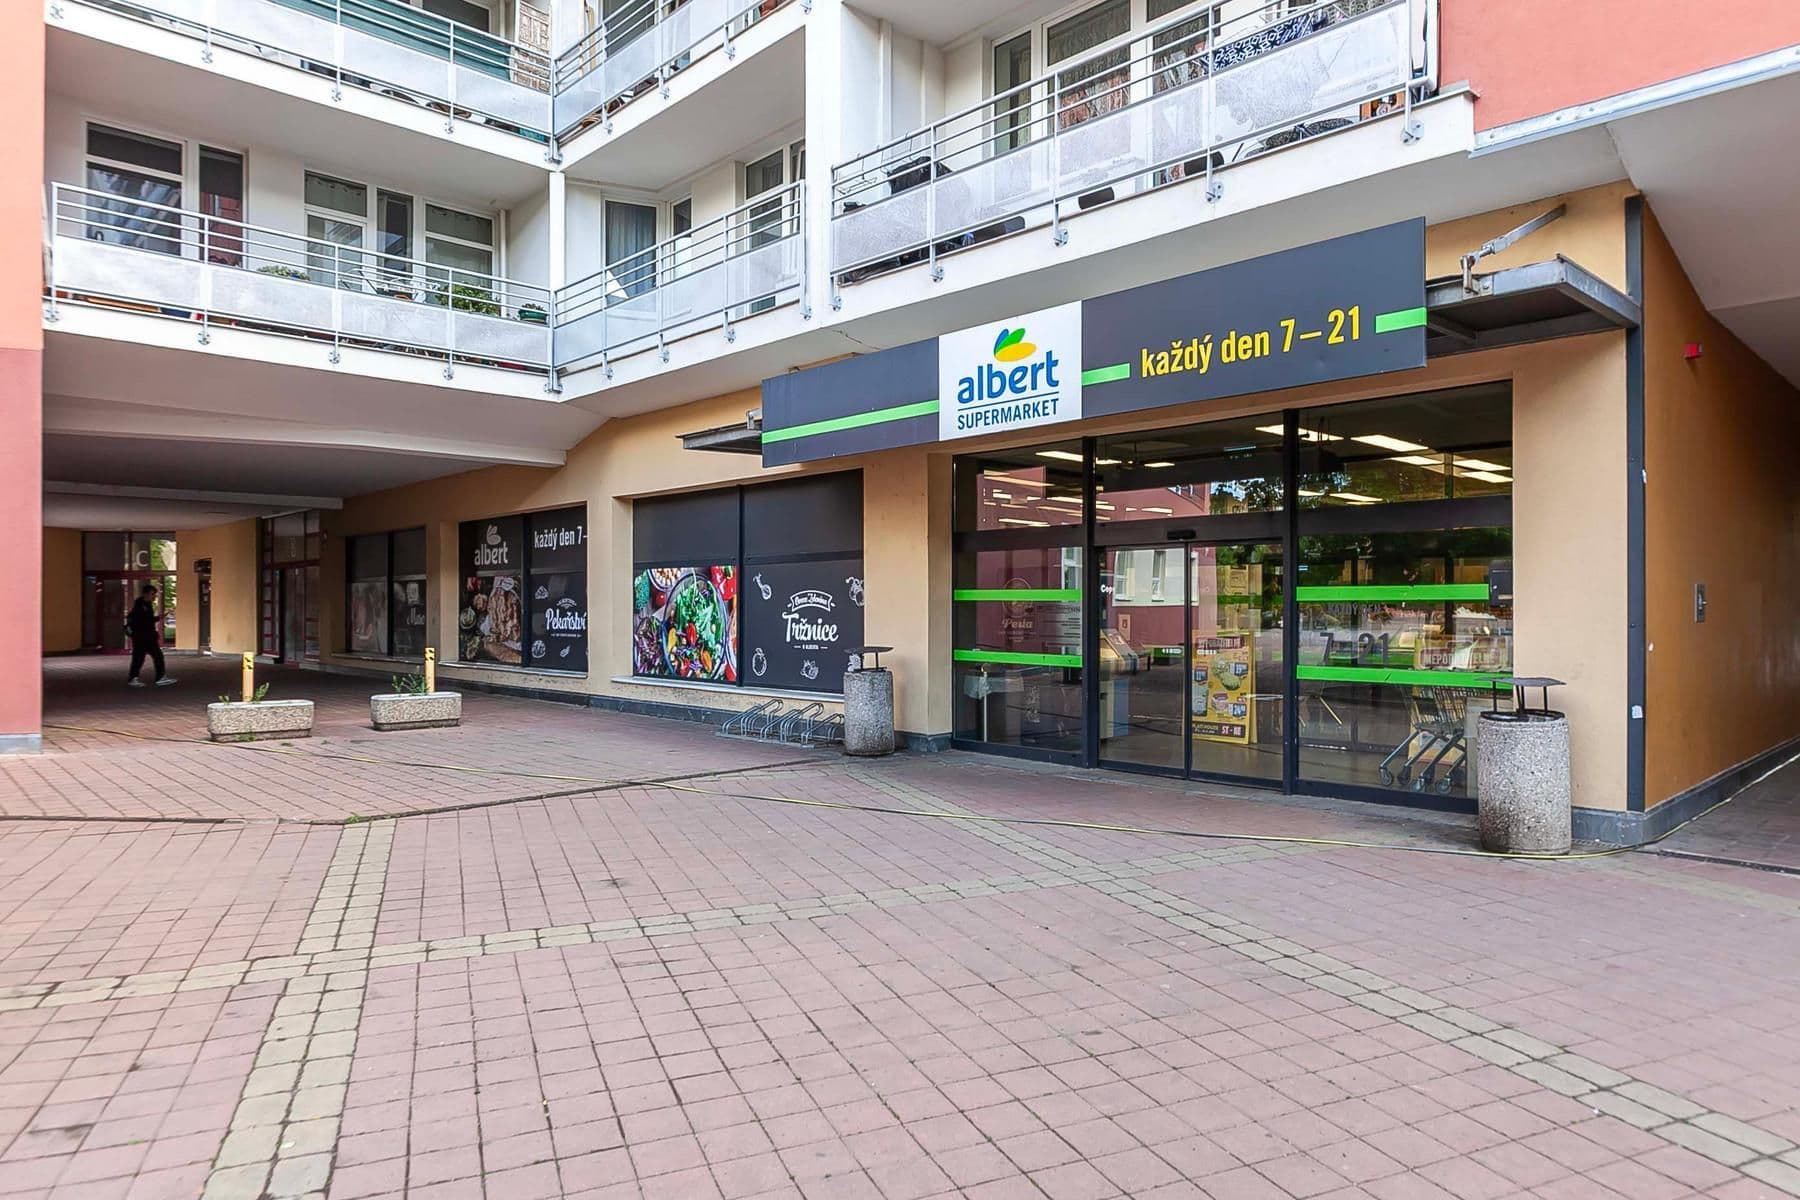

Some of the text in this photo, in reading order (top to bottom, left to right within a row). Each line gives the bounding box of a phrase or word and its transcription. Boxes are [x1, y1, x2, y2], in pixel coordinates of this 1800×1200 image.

[1142, 334, 1213, 378] každý
[1221, 330, 1270, 364] den
[957, 350, 1059, 404] albert
[957, 398, 1059, 430] SUPERMARKET
[474, 541, 509, 566] albert
[534, 528, 557, 550] každý
[560, 528, 575, 546] den
[545, 607, 588, 631] Pekařství
[782, 611, 839, 642] Tržnice
